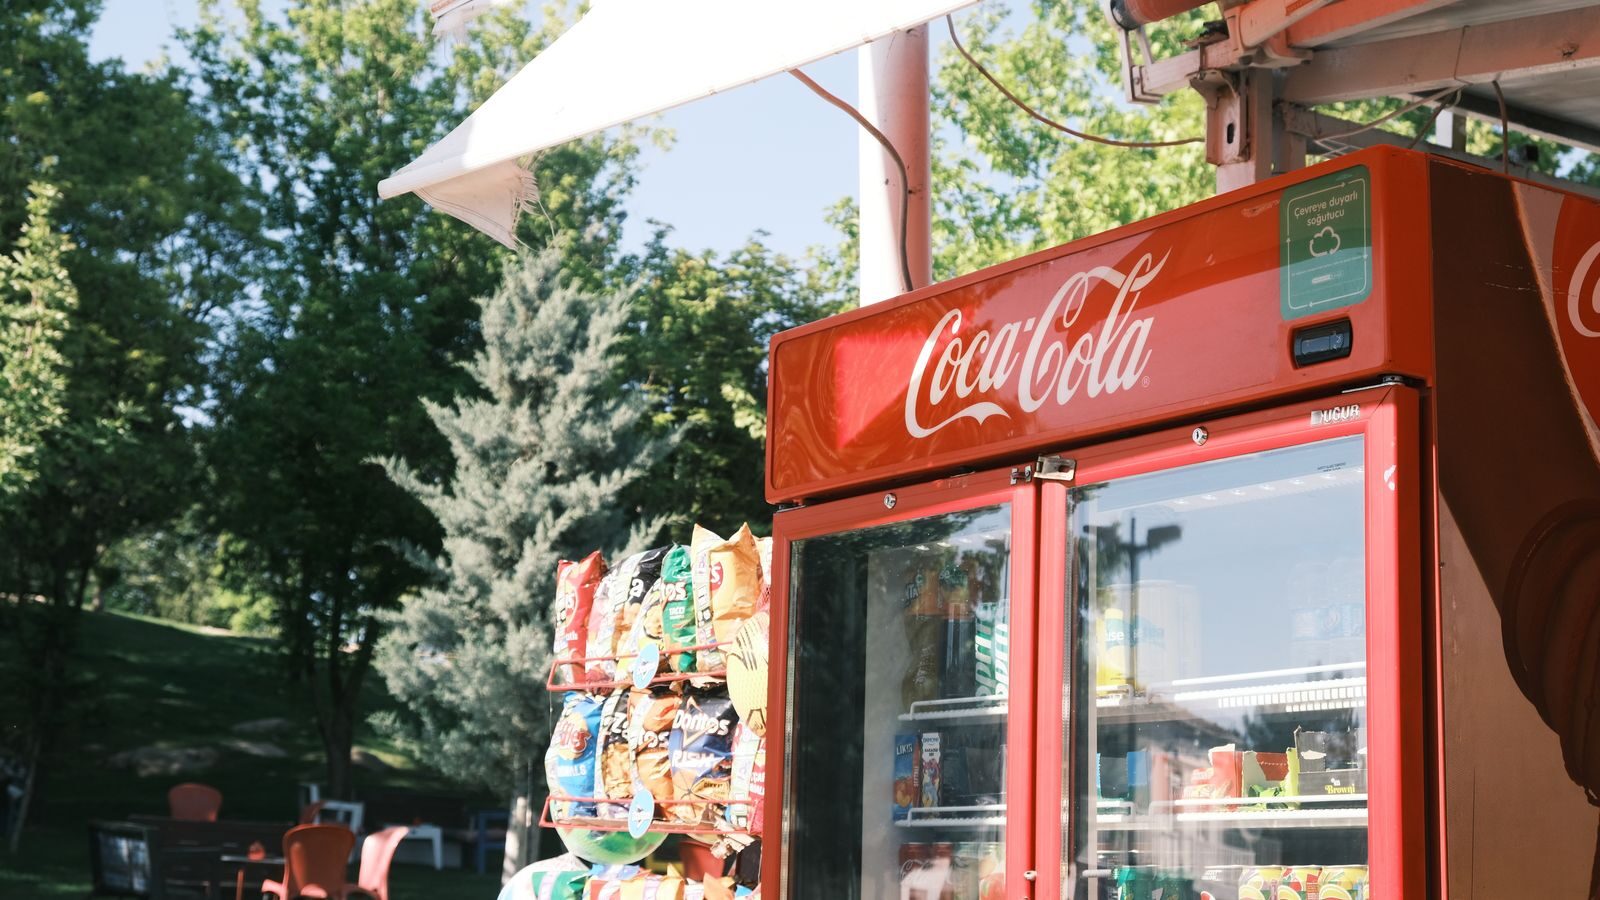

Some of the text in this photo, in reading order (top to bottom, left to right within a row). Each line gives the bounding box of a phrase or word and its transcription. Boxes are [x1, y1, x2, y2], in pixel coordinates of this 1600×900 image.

[1294, 190, 1358, 220] Çevreye duyarlı
[1307, 209, 1345, 226] soğutucu
[904, 246, 1172, 438] Coca-Cola
[672, 709, 730, 736] Doritos
